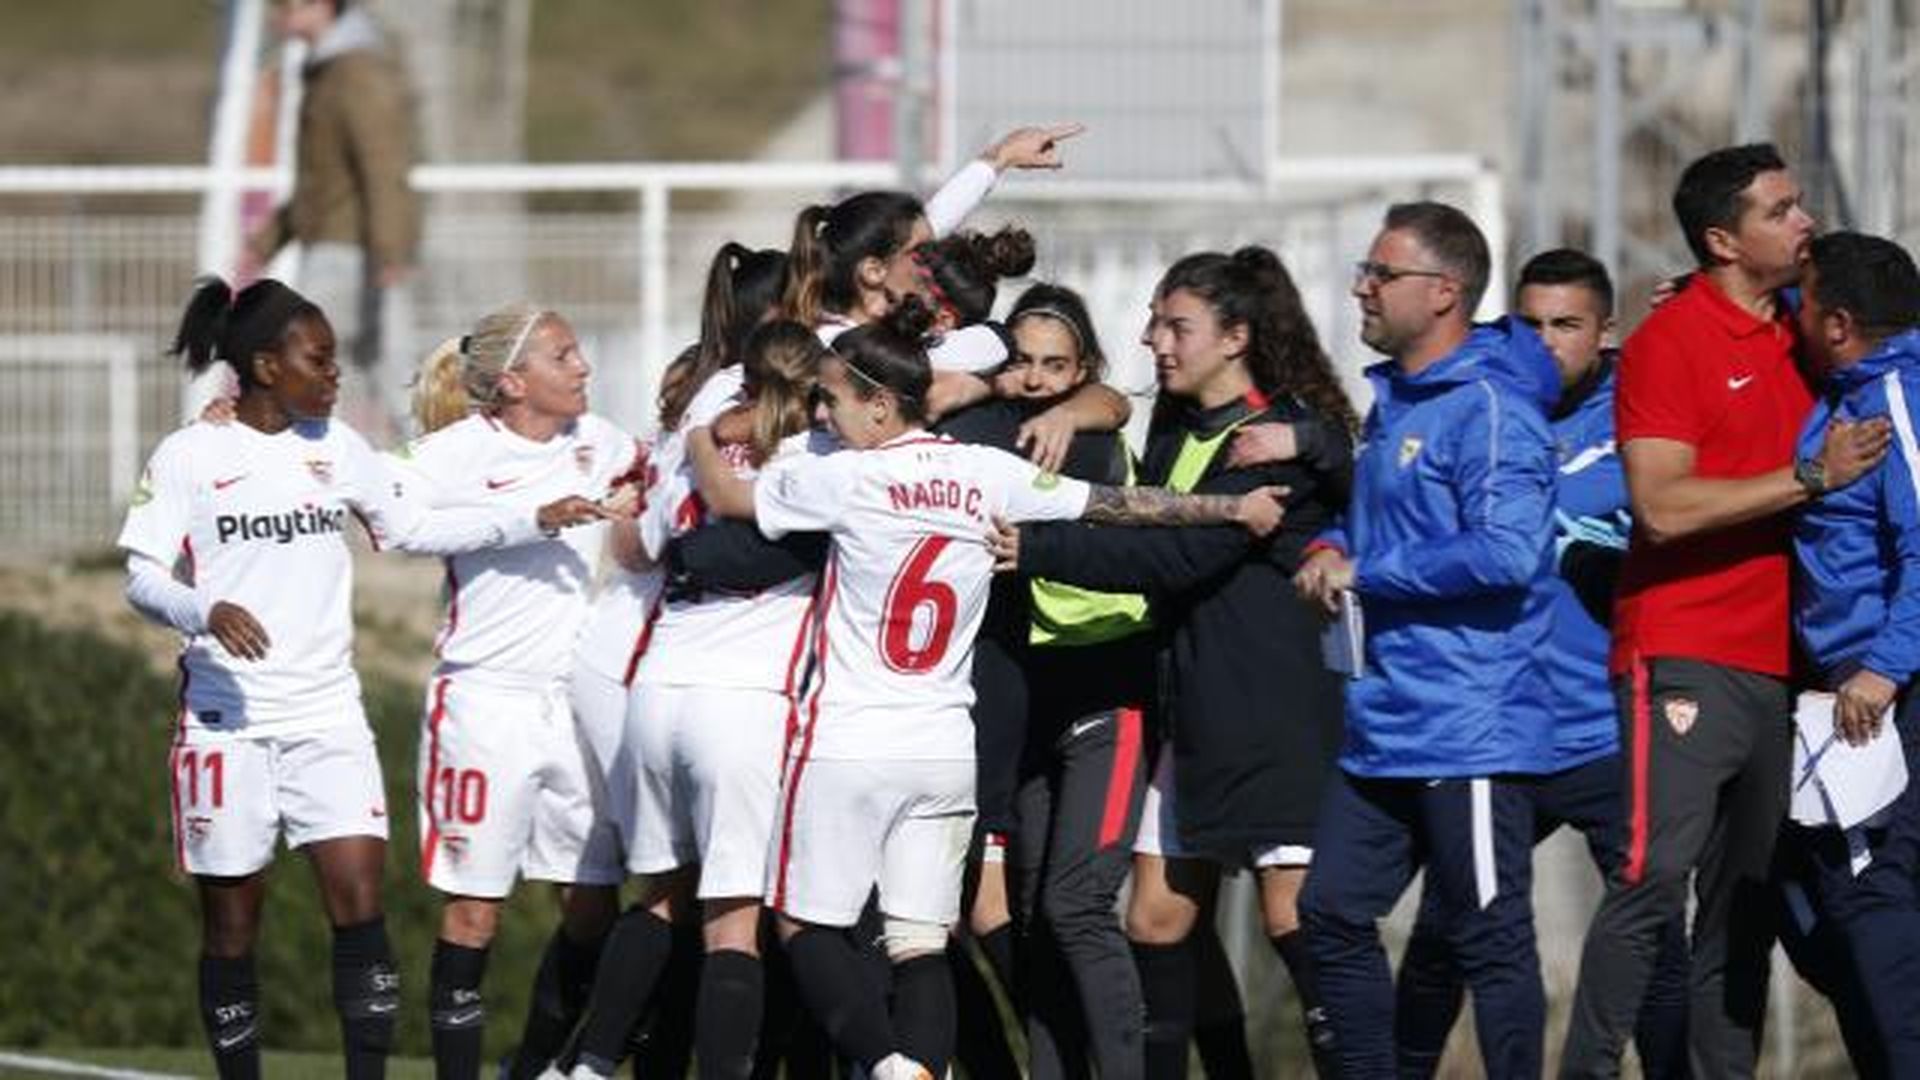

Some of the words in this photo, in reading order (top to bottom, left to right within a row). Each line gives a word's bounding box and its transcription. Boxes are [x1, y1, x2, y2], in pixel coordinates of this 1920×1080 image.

[887, 478, 962, 512] NAGO
[878, 532, 958, 675] 6
[181, 750, 224, 809] 11
[440, 766, 489, 825] 10
